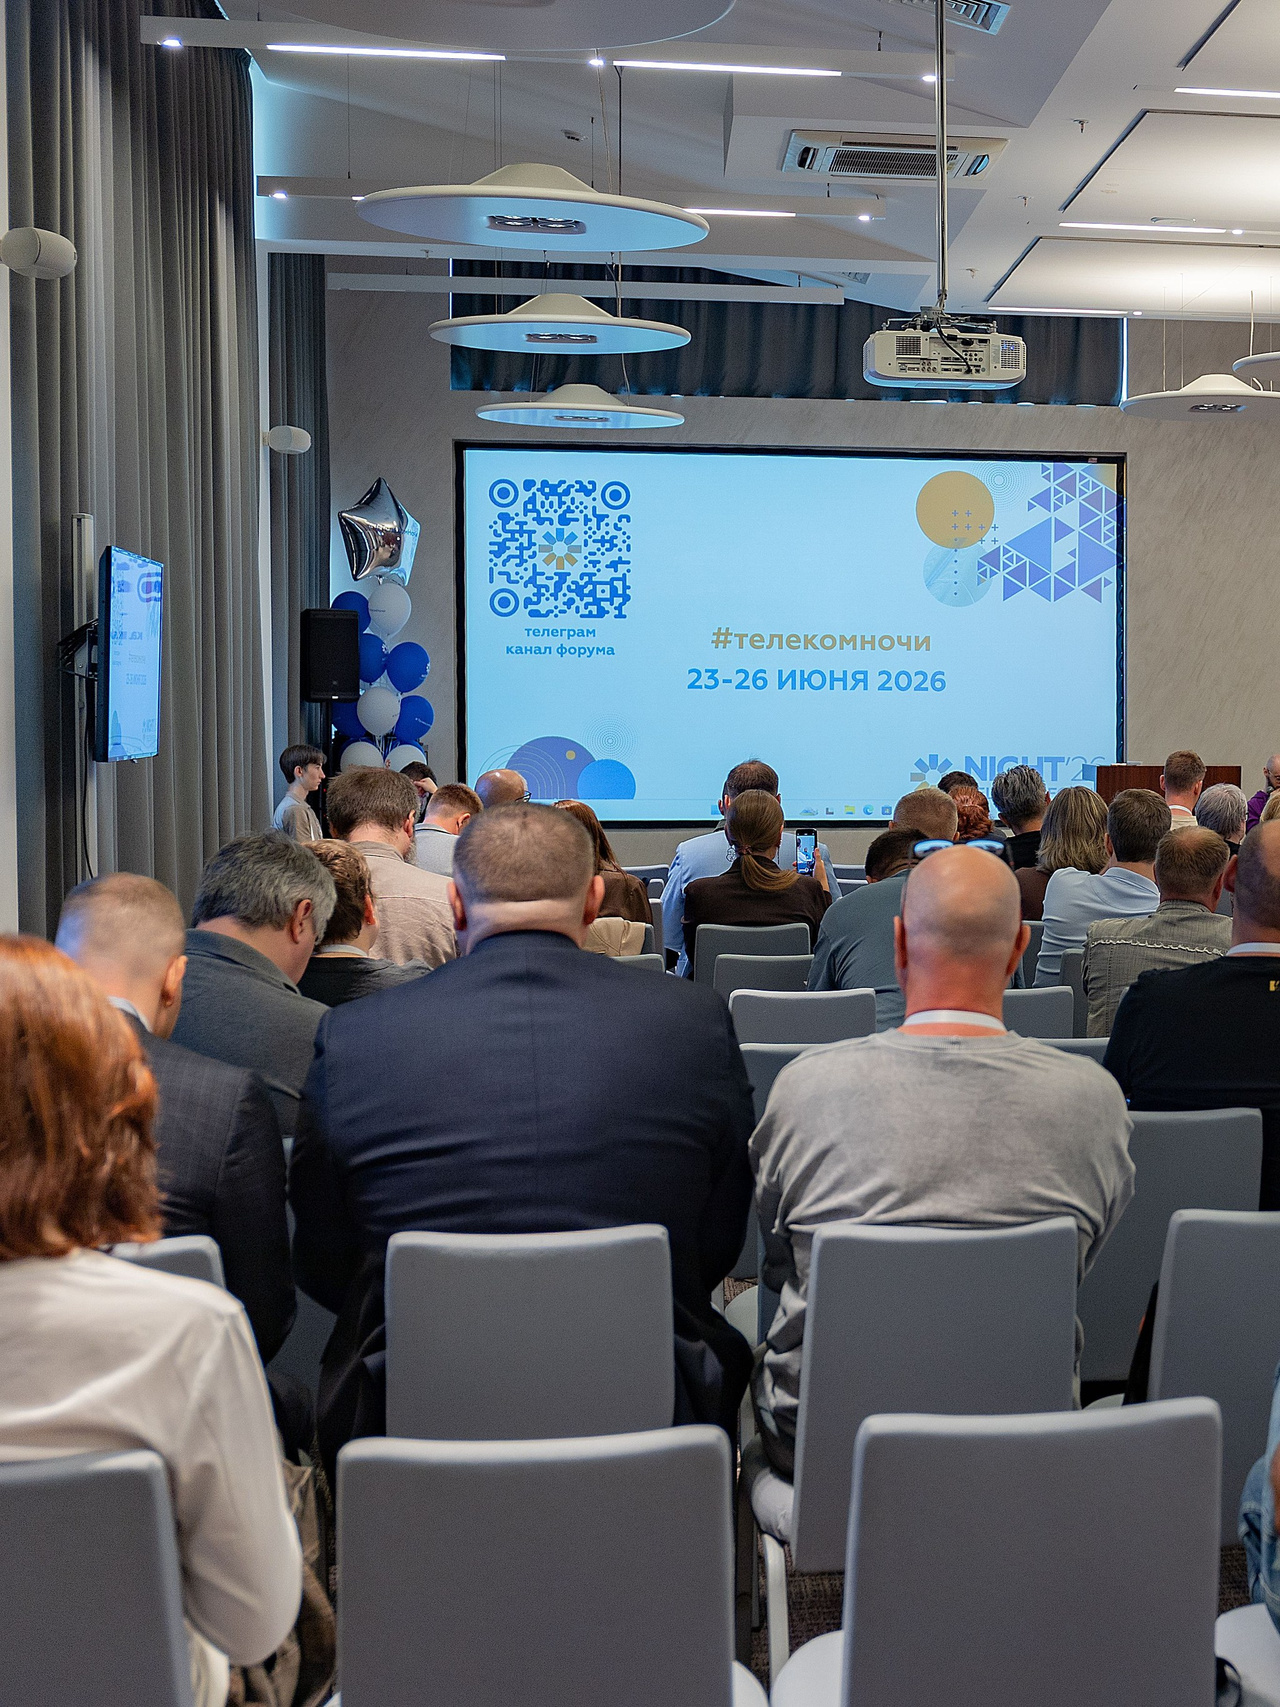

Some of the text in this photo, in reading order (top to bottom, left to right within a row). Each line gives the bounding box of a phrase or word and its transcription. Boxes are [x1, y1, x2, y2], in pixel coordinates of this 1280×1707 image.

[525, 628, 596, 640] телеграм
[711, 627, 931, 651] #телекомночи
[506, 643, 616, 658] канал форума
[687, 668, 947, 692] 23-26 ИЮНЯ 2026
